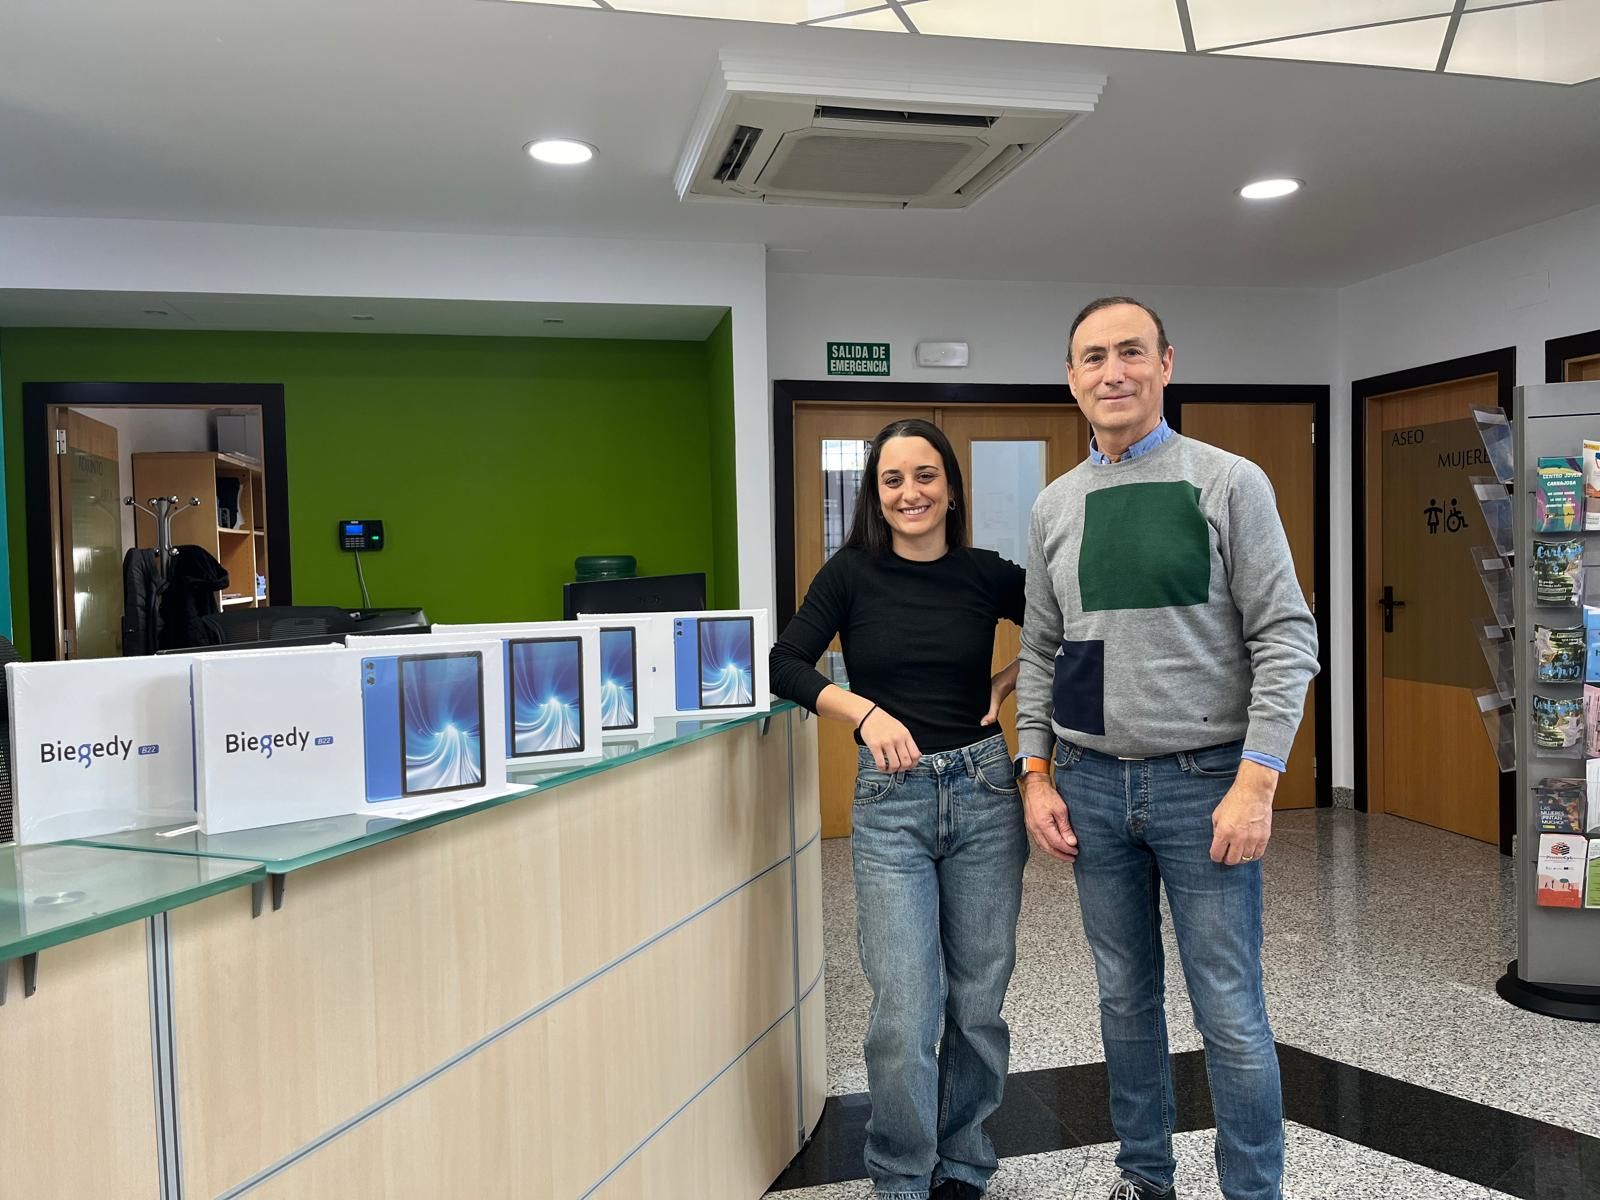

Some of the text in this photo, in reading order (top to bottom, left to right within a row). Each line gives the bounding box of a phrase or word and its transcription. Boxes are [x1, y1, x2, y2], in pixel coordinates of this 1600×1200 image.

[832, 345, 886, 359] SALIDA DE
[830, 359, 889, 373] EMERGENCIA
[1391, 429, 1425, 447] ASEO
[1437, 449, 1490, 470] MUJERE
[40, 734, 158, 768] Biegedy B22
[226, 726, 310, 759] Biegedy
